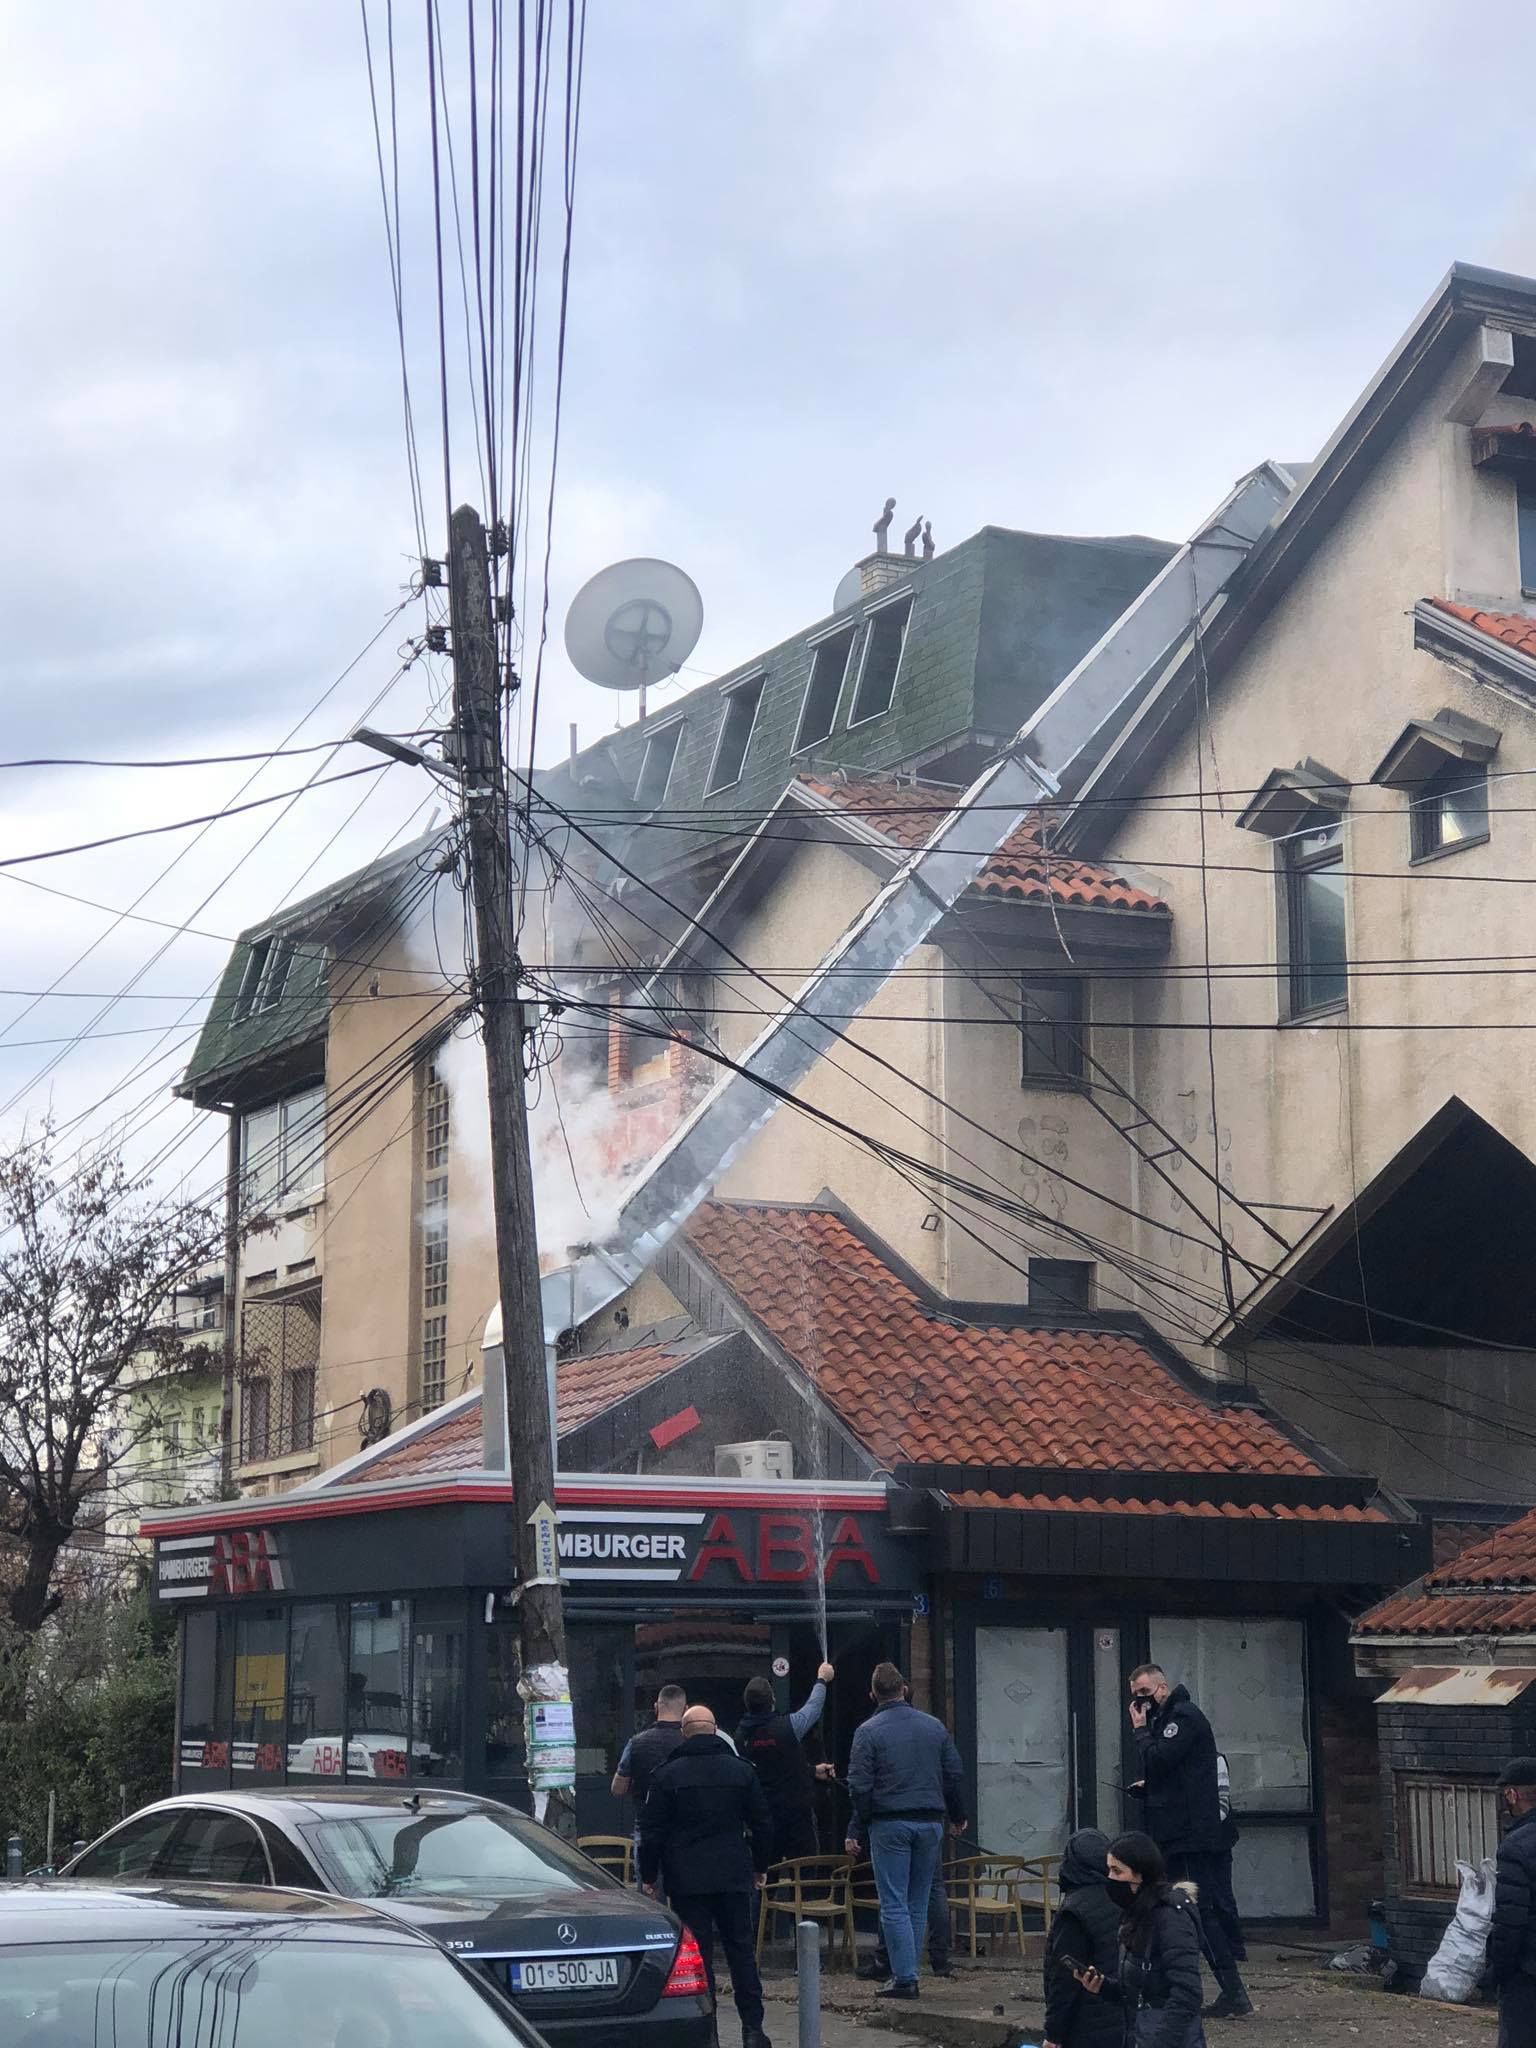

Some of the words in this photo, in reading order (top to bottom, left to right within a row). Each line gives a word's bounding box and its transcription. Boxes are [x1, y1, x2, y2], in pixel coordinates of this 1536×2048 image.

[159, 1556, 211, 1581] HAMBURGER
[208, 1530, 285, 1594] ABA
[557, 1533, 687, 1560] MBURGER
[687, 1514, 880, 1584] ABA
[314, 1746, 342, 1773] ABA
[525, 1964, 545, 1987] 01
